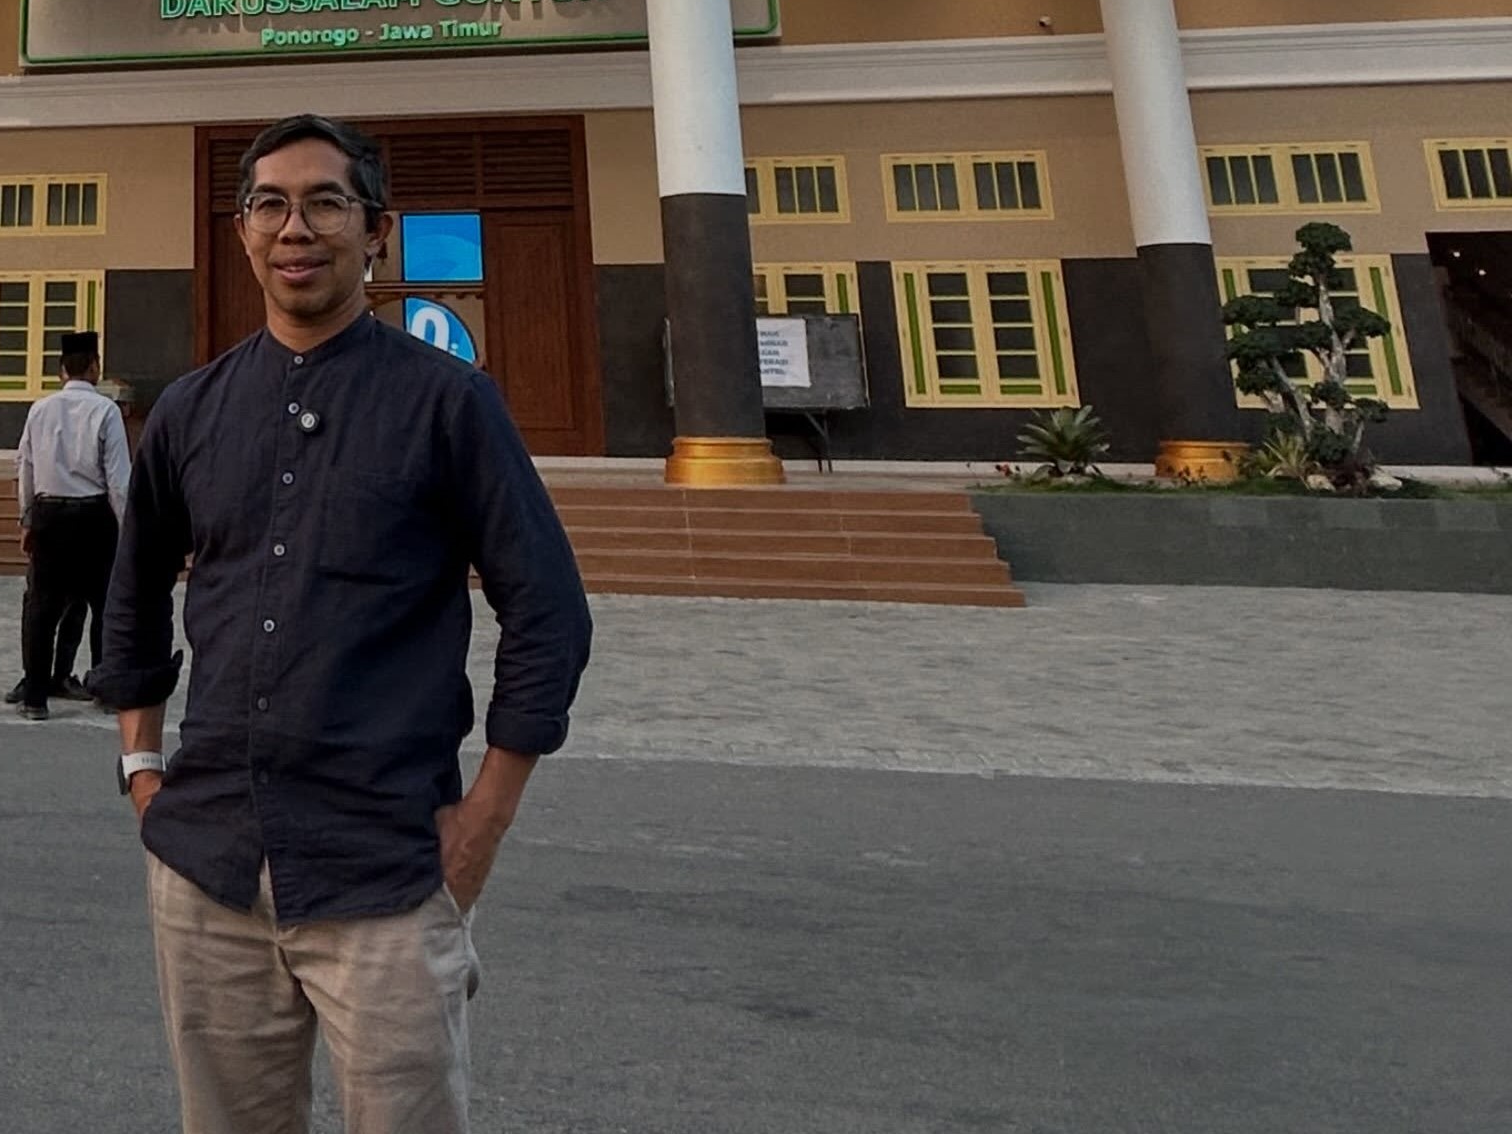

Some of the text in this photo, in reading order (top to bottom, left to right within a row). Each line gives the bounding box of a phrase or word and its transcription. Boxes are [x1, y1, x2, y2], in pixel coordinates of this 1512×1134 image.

[260, 26, 360, 47] Ponorogo
[378, 23, 433, 41] Jawa
[439, 19, 502, 39] Timur
